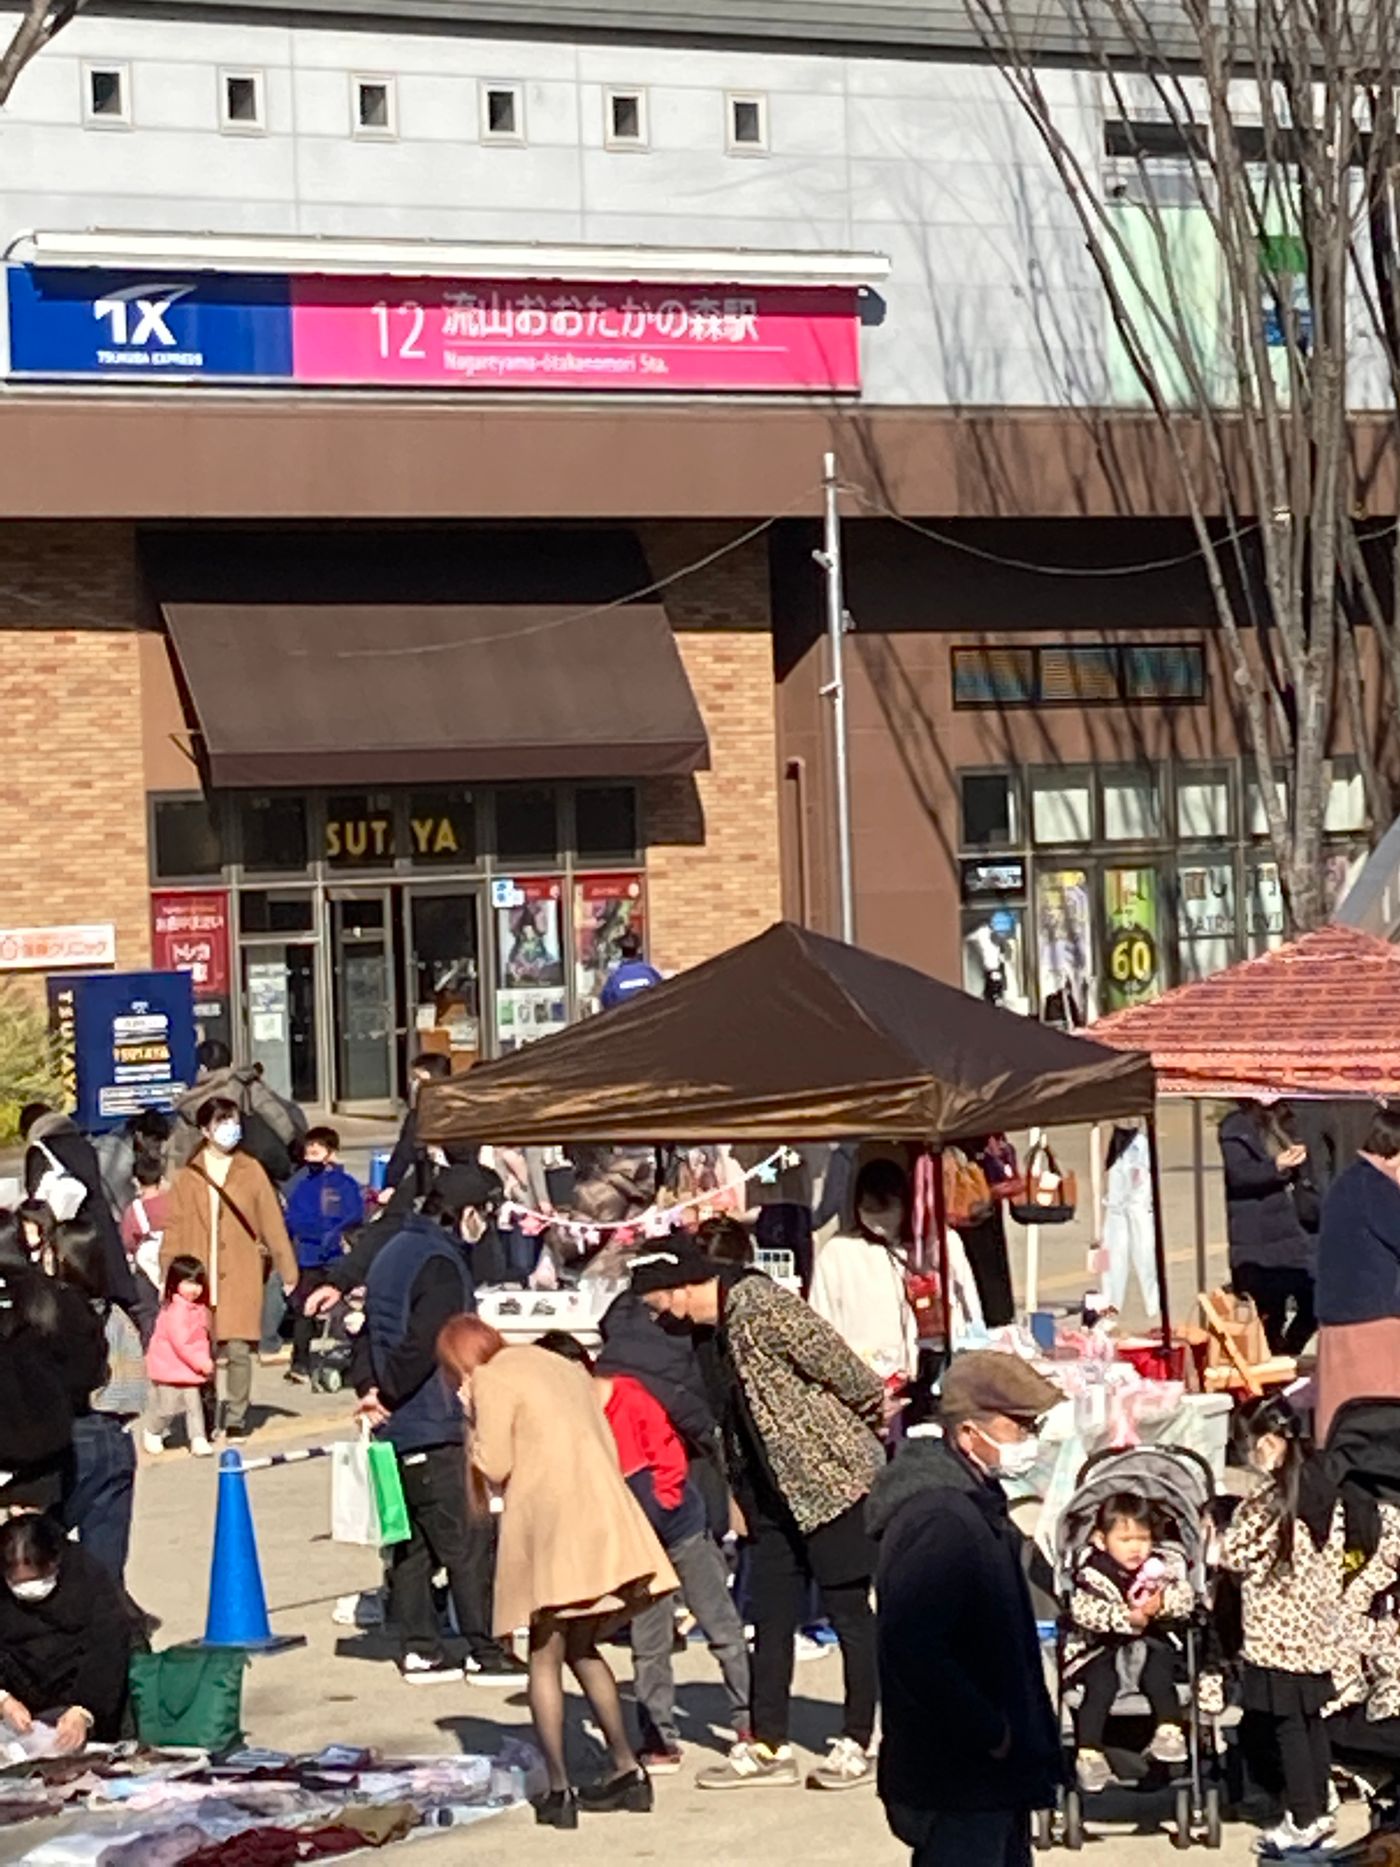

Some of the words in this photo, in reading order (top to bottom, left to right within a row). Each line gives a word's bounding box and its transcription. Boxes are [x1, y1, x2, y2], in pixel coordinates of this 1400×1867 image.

[371, 301, 427, 359] 12
[441, 291, 759, 341] 流山おおたかの森駅
[1111, 940, 1152, 982] 60
